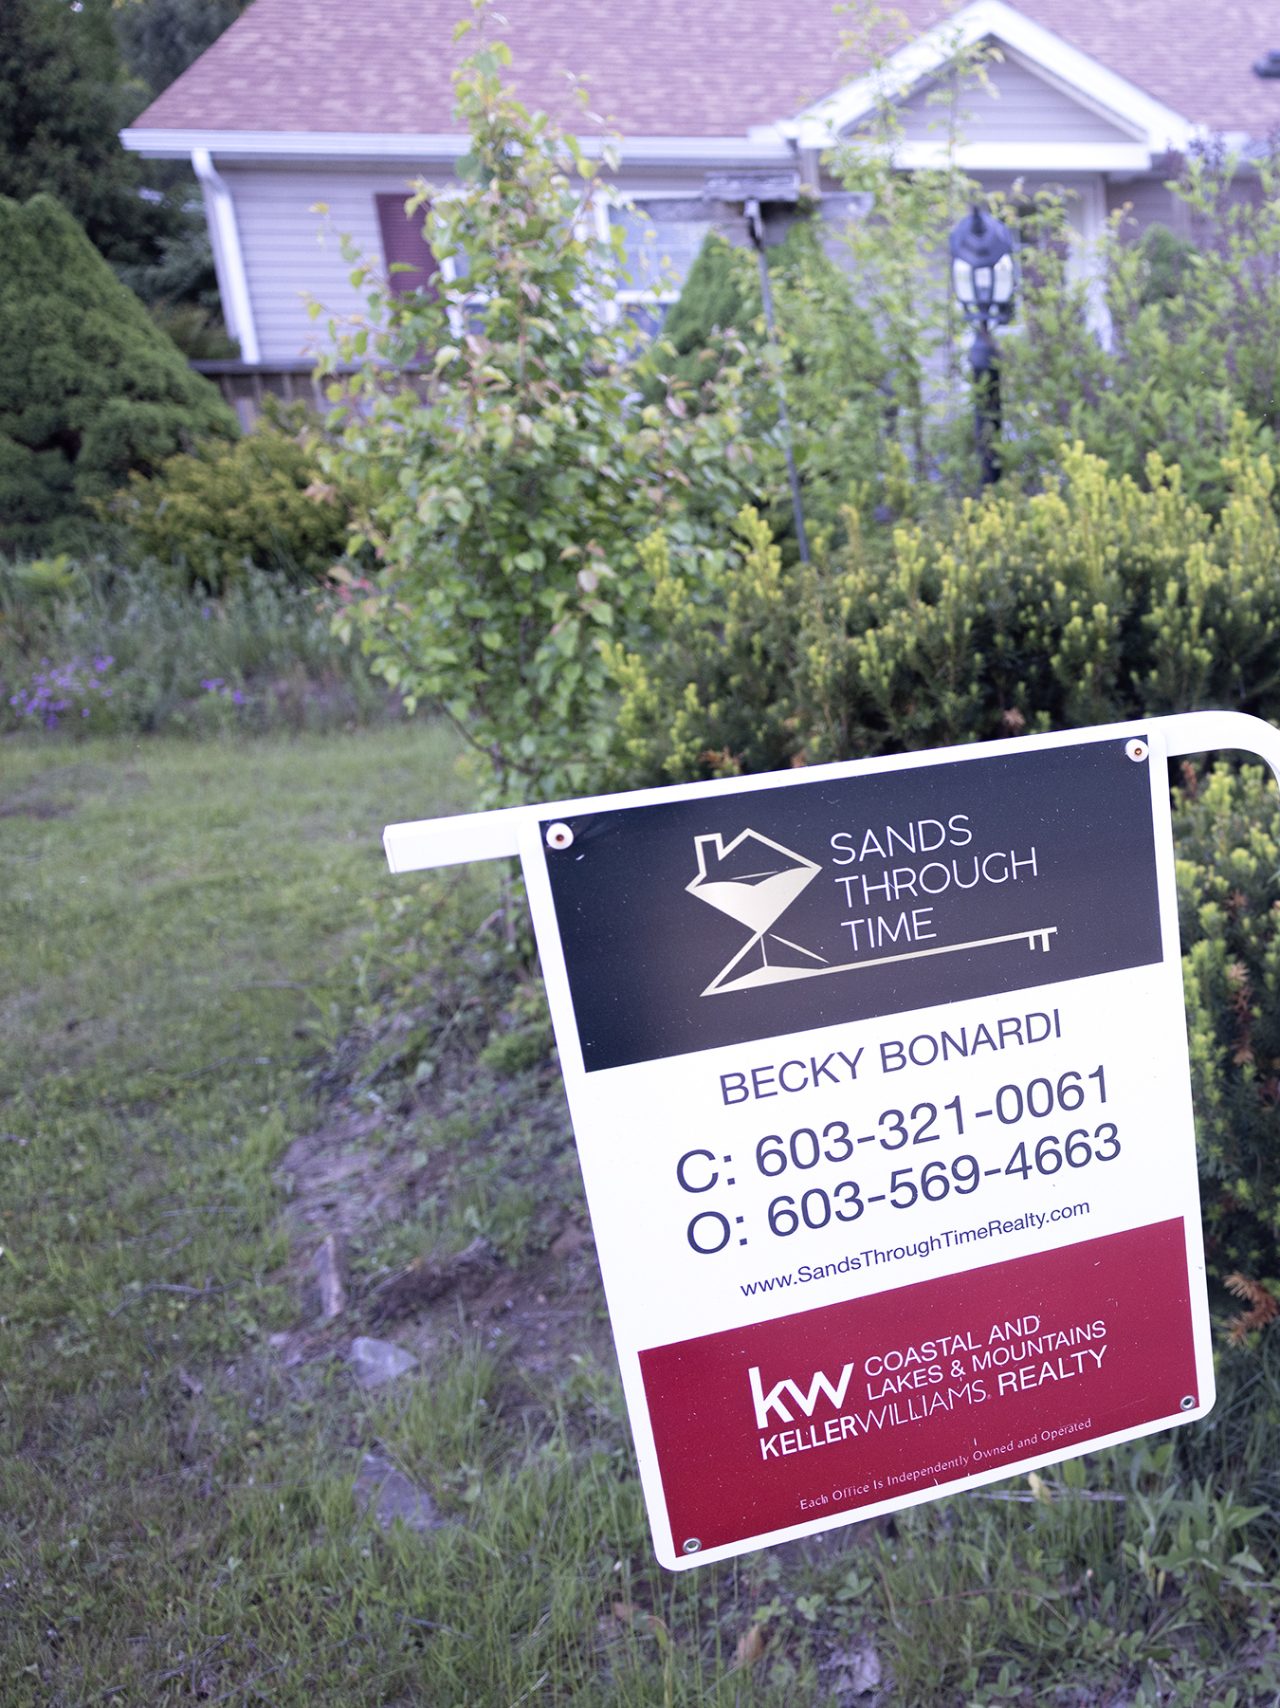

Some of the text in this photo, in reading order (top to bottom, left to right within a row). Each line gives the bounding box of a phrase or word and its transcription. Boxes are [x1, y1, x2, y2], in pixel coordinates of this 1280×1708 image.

[829, 813, 972, 866] SANDS
[834, 846, 1038, 909] THROUGH
[840, 907, 937, 952] TIME
[719, 1008, 1062, 1106] BECKY BONARDI
[675, 1063, 1109, 1194] C: 603-321-0061
[686, 1122, 1122, 1256] O: 603-569-4663
[739, 1200, 1091, 1298] www.SandsThroughTimeRealty.com
[863, 1314, 1042, 1377] COASTAL AND
[865, 1319, 1108, 1401] LAKES & MOUNTAINS
[997, 1344, 1109, 1397] REALTY
[747, 1362, 855, 1430] kw
[799, 1417, 1093, 1511] Each Office Is Independently Owned and Operated
